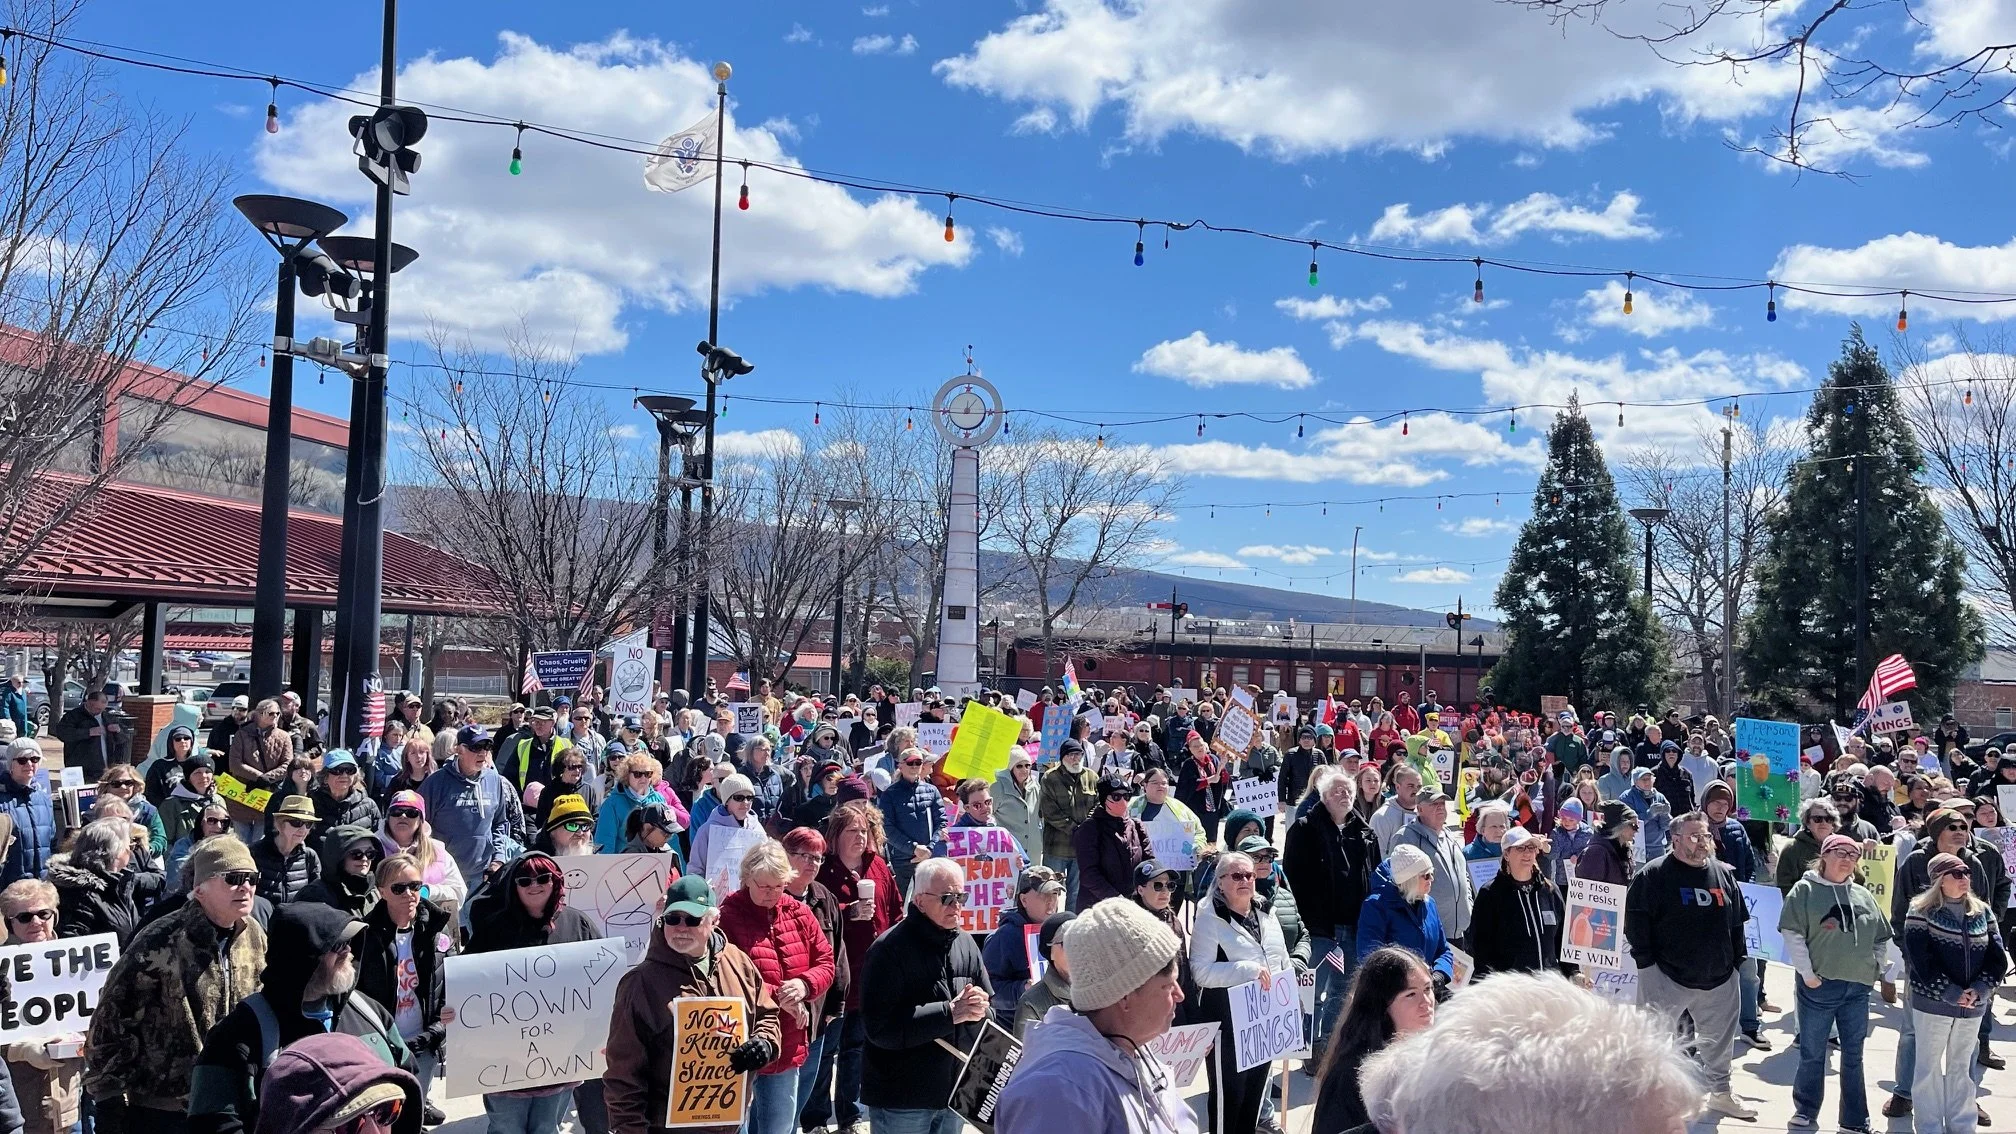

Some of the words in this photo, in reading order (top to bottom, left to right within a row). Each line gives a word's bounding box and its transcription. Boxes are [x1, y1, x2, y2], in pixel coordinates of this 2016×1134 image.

[628, 648, 643, 660] NO
[363, 679, 382, 693] NO
[614, 702, 644, 713] KINGS
[923, 728, 945, 736] HANDS
[1741, 720, 1746, 732] A
[1872, 717, 1911, 732] KINGS
[1237, 777, 1276, 790] FREO
[1240, 791, 1276, 803] DEMOCR
[948, 830, 1013, 857] IRAN
[1570, 879, 1583, 888] we
[1590, 883, 1610, 893] rise
[1570, 891, 1583, 900] we
[1589, 894, 1618, 906] resist
[1680, 887, 1724, 906] FDT
[960, 907, 1000, 931] ILE
[625, 937, 646, 951] ash
[44, 943, 113, 977] THE
[1562, 948, 1581, 960] WE
[1588, 952, 1619, 967] WIN!
[505, 954, 556, 985] NO
[1595, 971, 1638, 985] PEOPLE
[1297, 974, 1314, 987] NGS
[1, 987, 104, 1030] EOPL
[460, 987, 592, 1029] CROWN
[1244, 983, 1270, 1022] NO
[684, 1005, 732, 1030] No
[521, 1022, 554, 1039] FOR
[1240, 1009, 1299, 1067] KINGS!
[527, 1041, 539, 1057] A
[680, 1032, 741, 1059] Kings
[1152, 1027, 1209, 1055] DUMP
[1005, 1045, 1023, 1065] THE
[478, 1051, 593, 1087] CLOWN
[678, 1060, 736, 1083] Since
[677, 1081, 737, 1111] 1776
[977, 1062, 1014, 1123] CONSTITUTION
